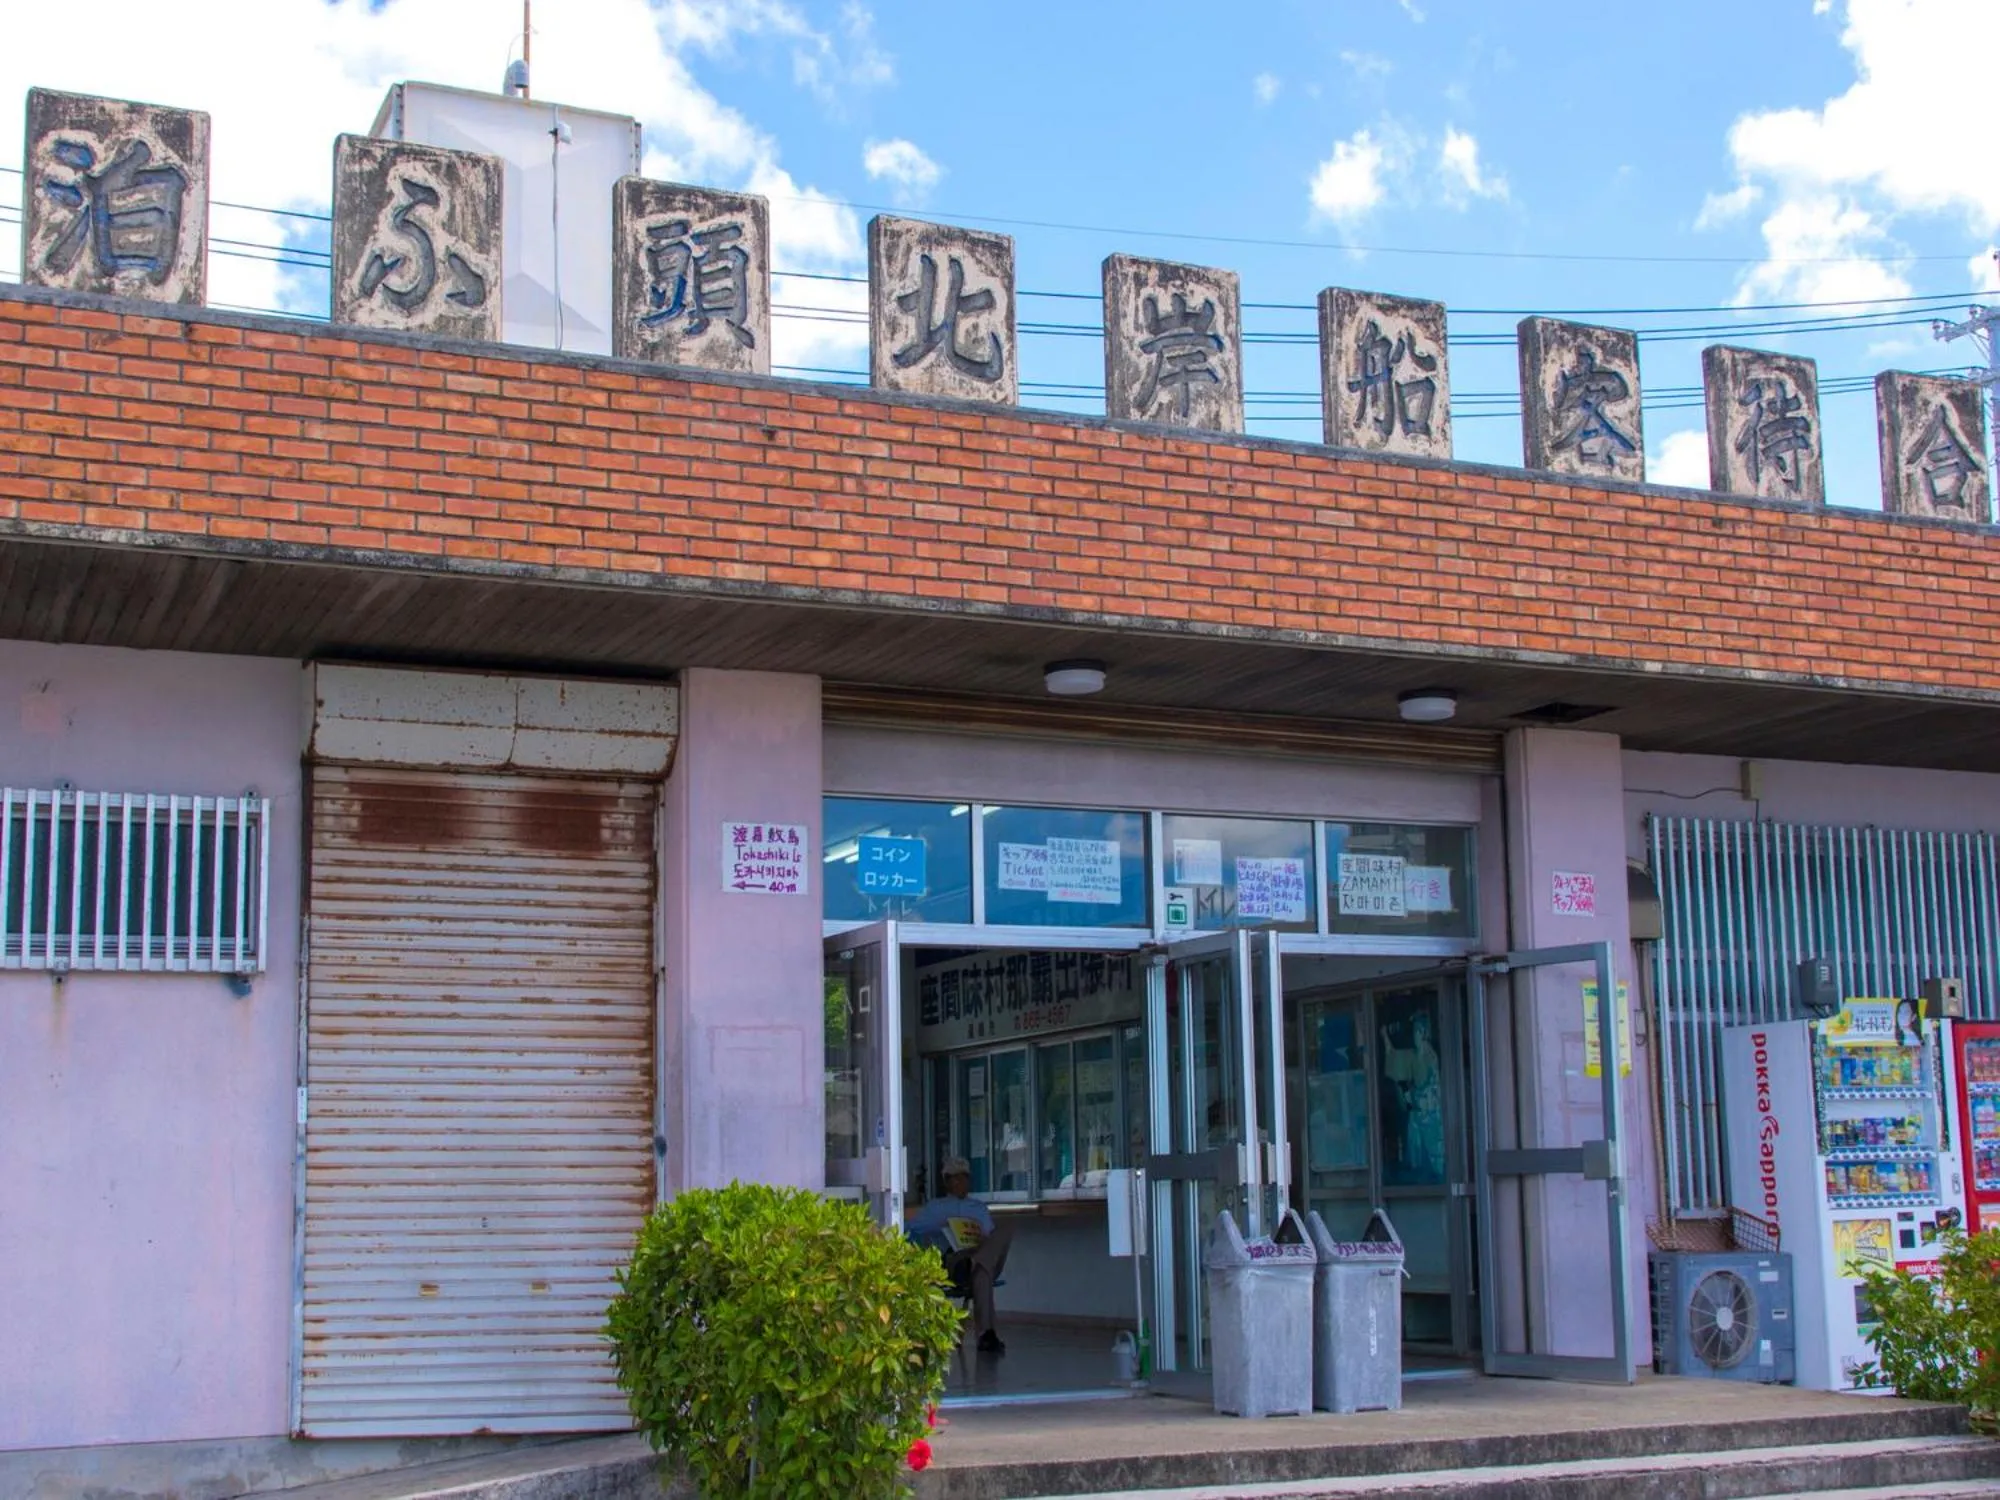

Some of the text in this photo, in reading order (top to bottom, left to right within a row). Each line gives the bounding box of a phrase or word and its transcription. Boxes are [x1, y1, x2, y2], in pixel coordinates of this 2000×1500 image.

[871, 847, 911, 863] コイン
[864, 872, 918, 888] ロッカー
[1342, 875, 1398, 892] ZAMAMI
[868, 896, 912, 917] トイレ
